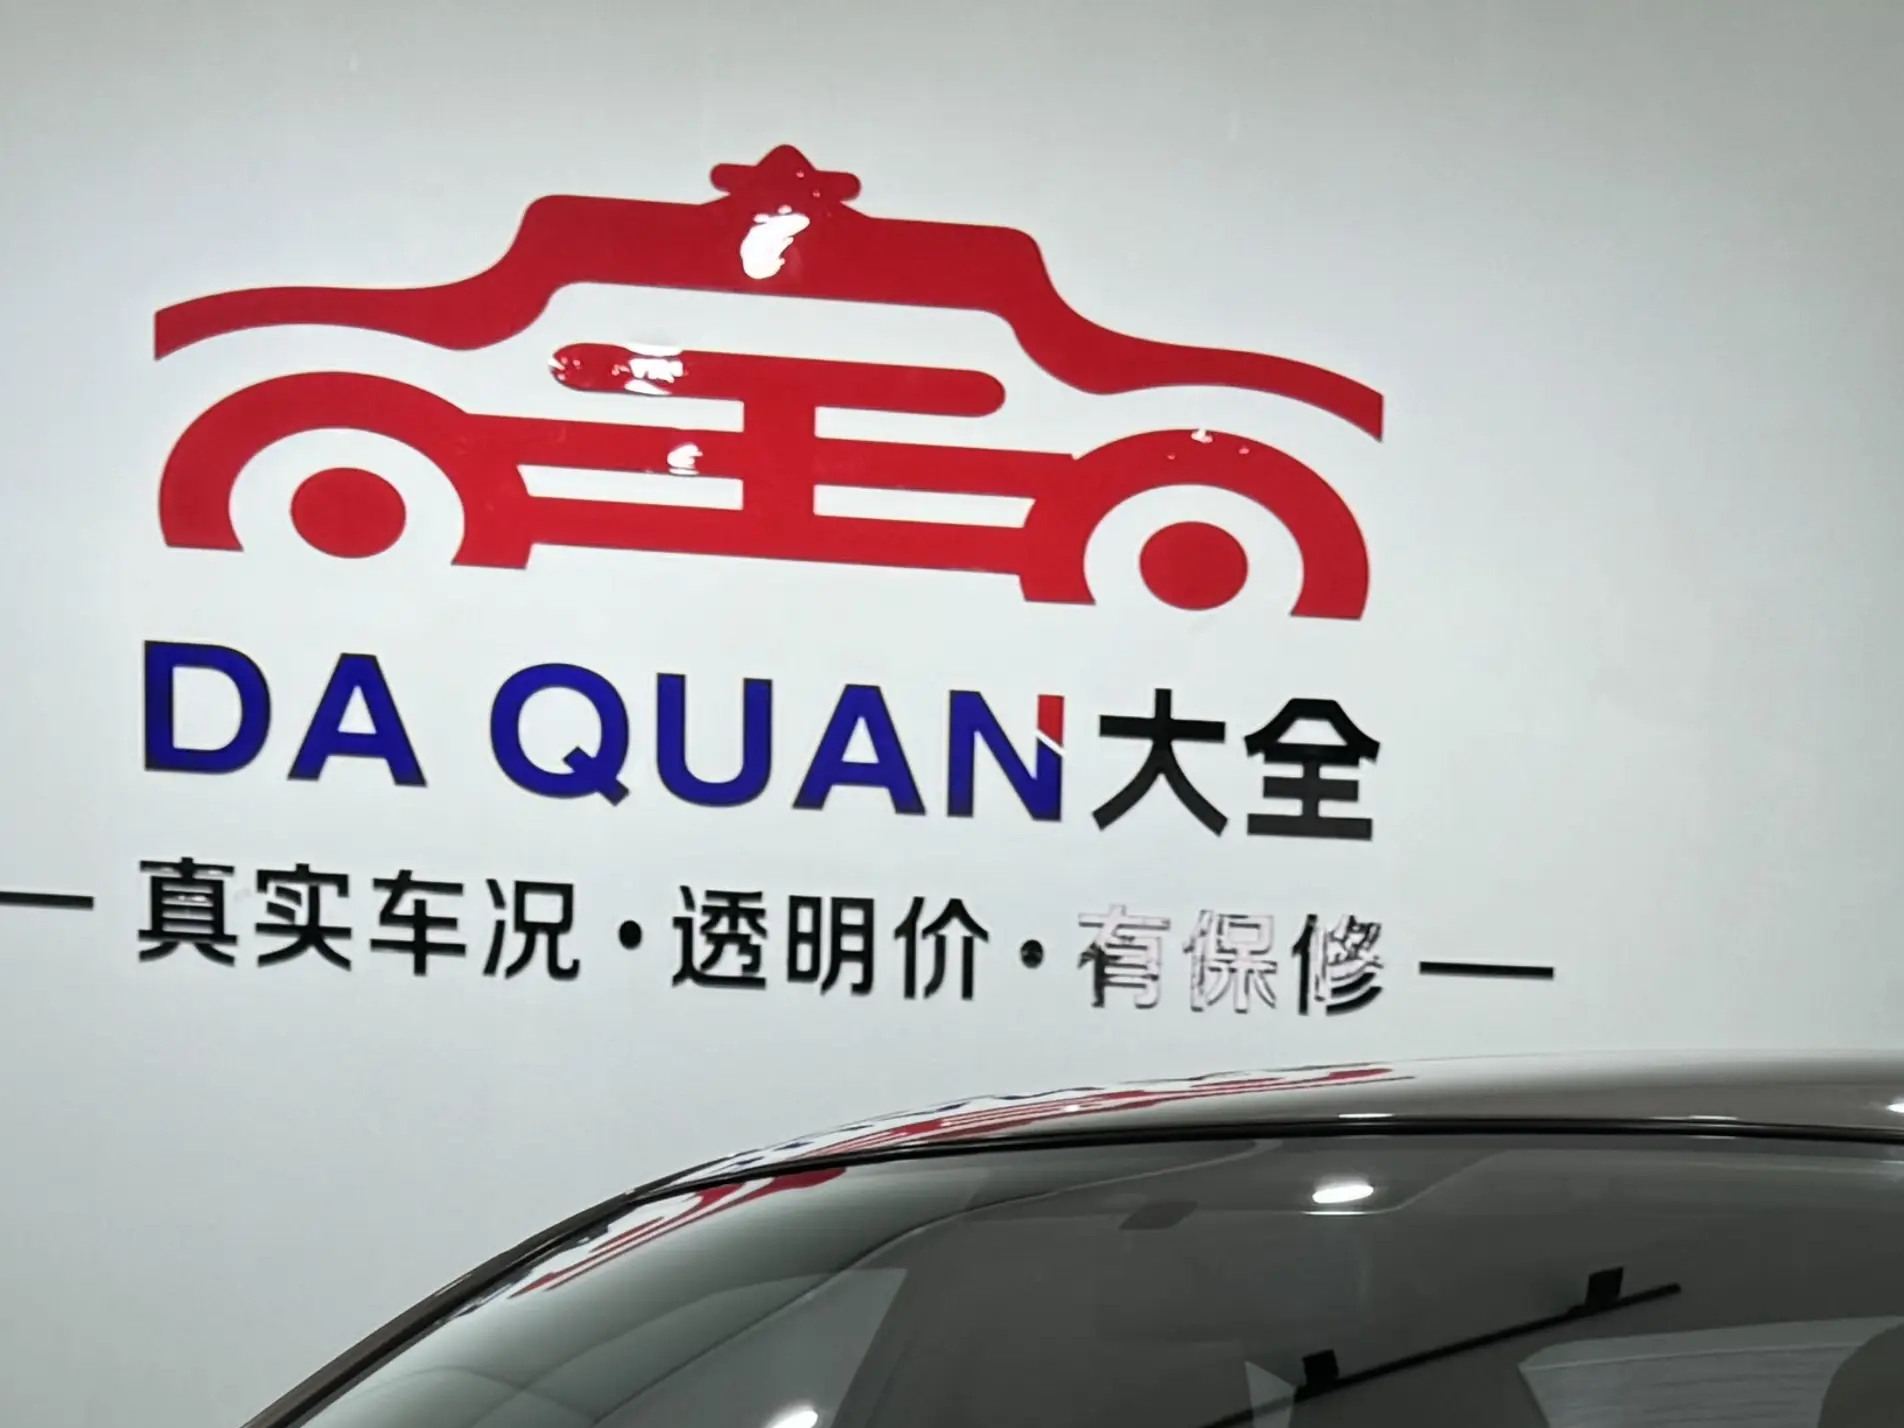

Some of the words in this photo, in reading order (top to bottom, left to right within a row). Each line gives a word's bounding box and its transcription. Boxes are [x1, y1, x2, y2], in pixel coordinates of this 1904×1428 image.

[143, 639, 428, 788] DA
[489, 662, 1065, 823] QUAN
[1091, 687, 1382, 842] 大全
